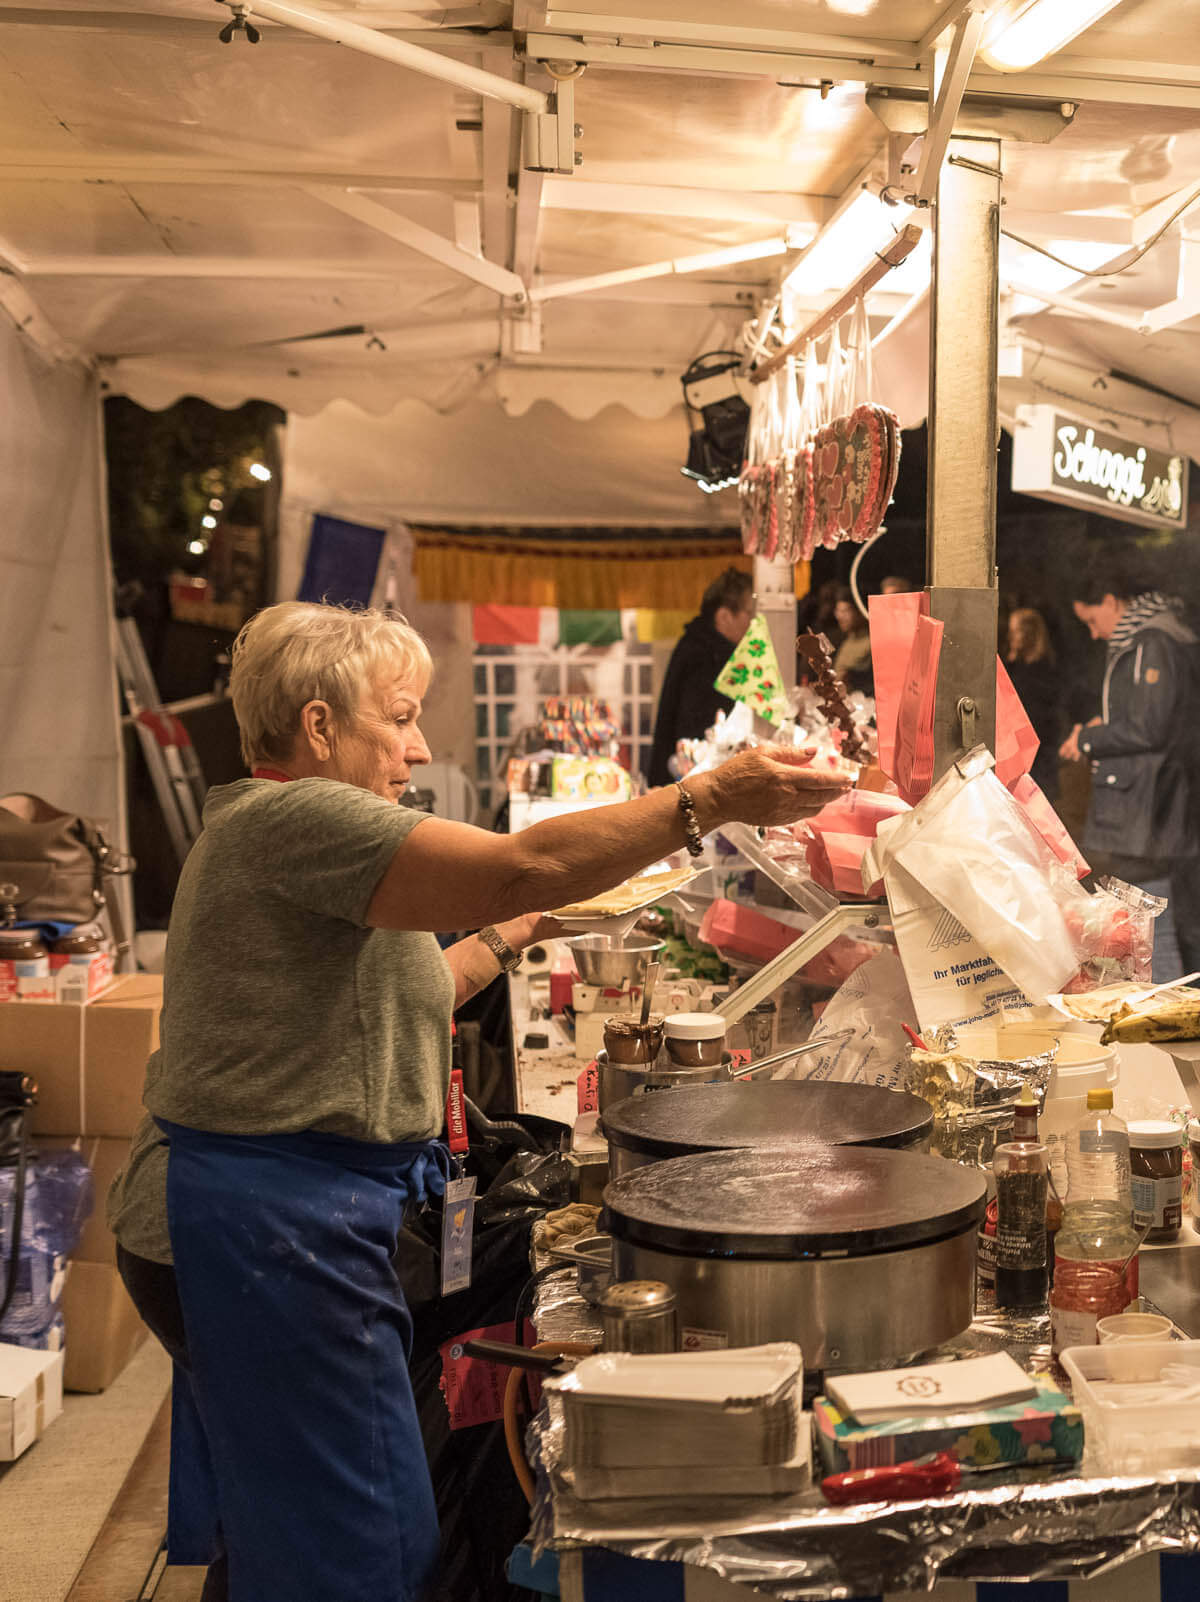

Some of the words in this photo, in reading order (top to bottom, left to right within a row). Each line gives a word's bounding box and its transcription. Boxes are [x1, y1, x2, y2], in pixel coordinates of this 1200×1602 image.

[1054, 425, 1147, 506] Schoggi
[933, 969, 948, 980] Ihr
[956, 974, 971, 987] für
